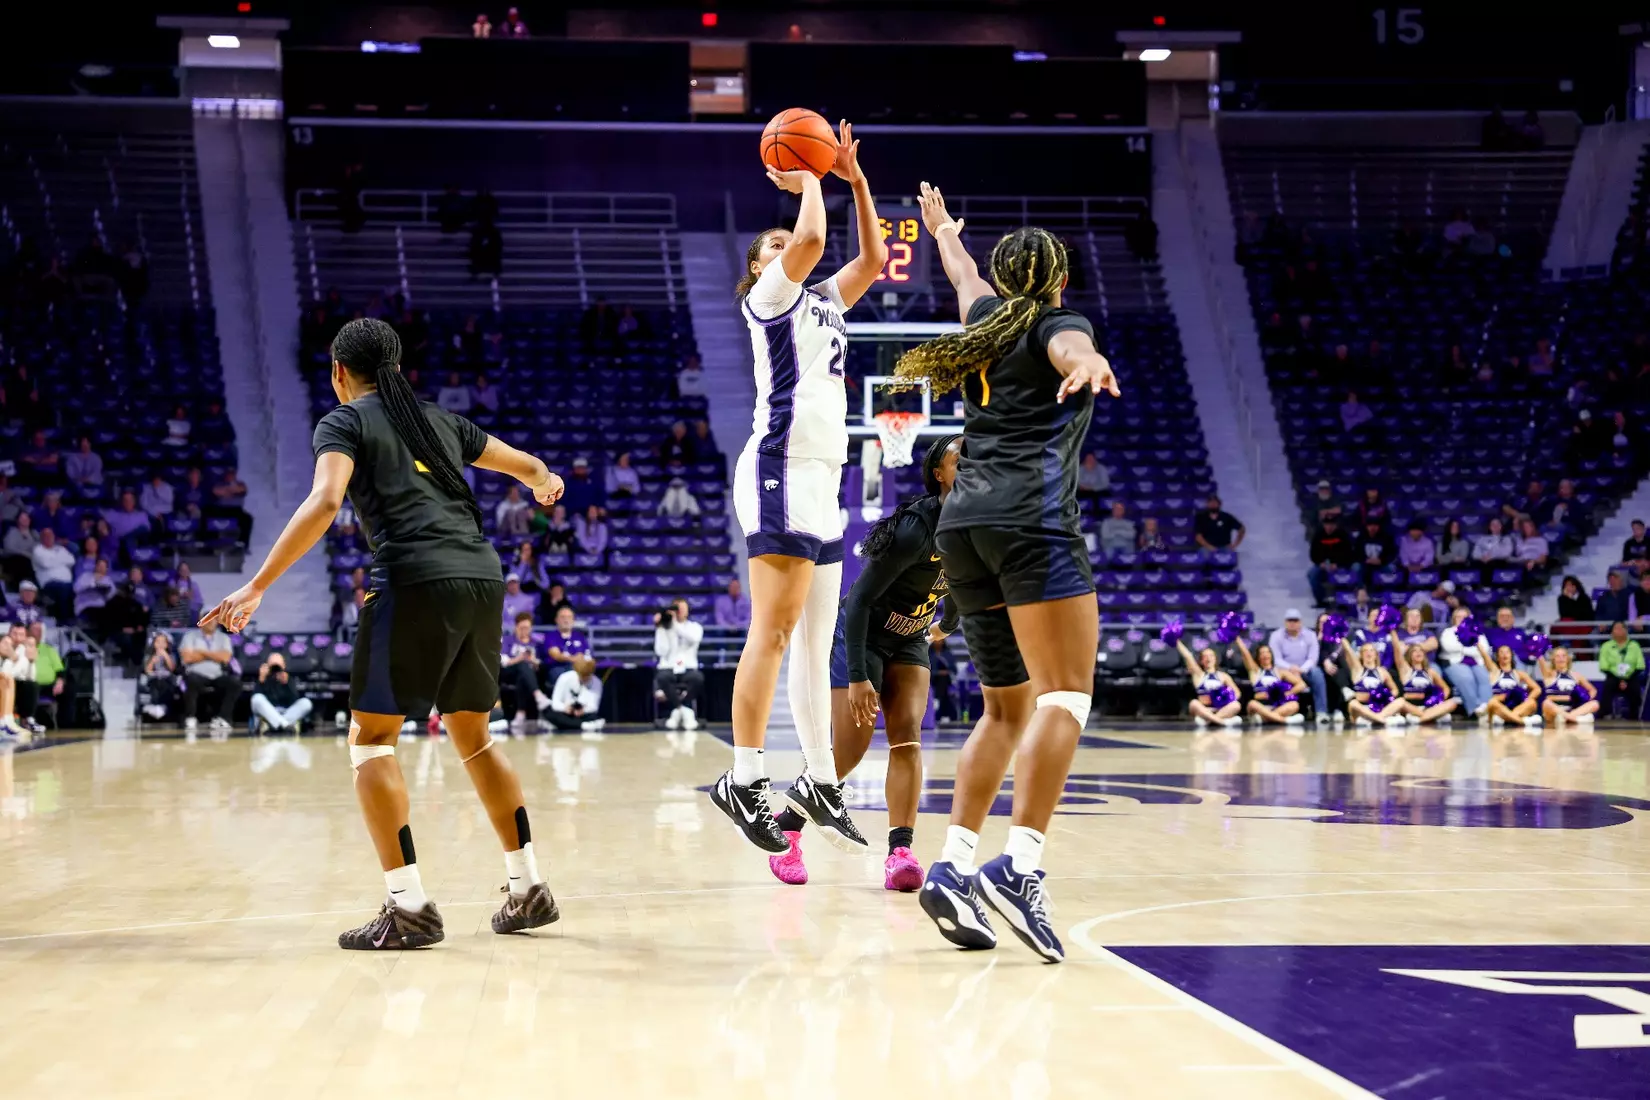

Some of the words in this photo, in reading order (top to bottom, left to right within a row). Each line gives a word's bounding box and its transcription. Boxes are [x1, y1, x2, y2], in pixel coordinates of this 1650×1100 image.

[1371, 9, 1424, 44] 15
[292, 127, 313, 144] 13
[1126, 136, 1146, 153] 14
[875, 243, 912, 281] 2
[828, 336, 848, 378] 2
